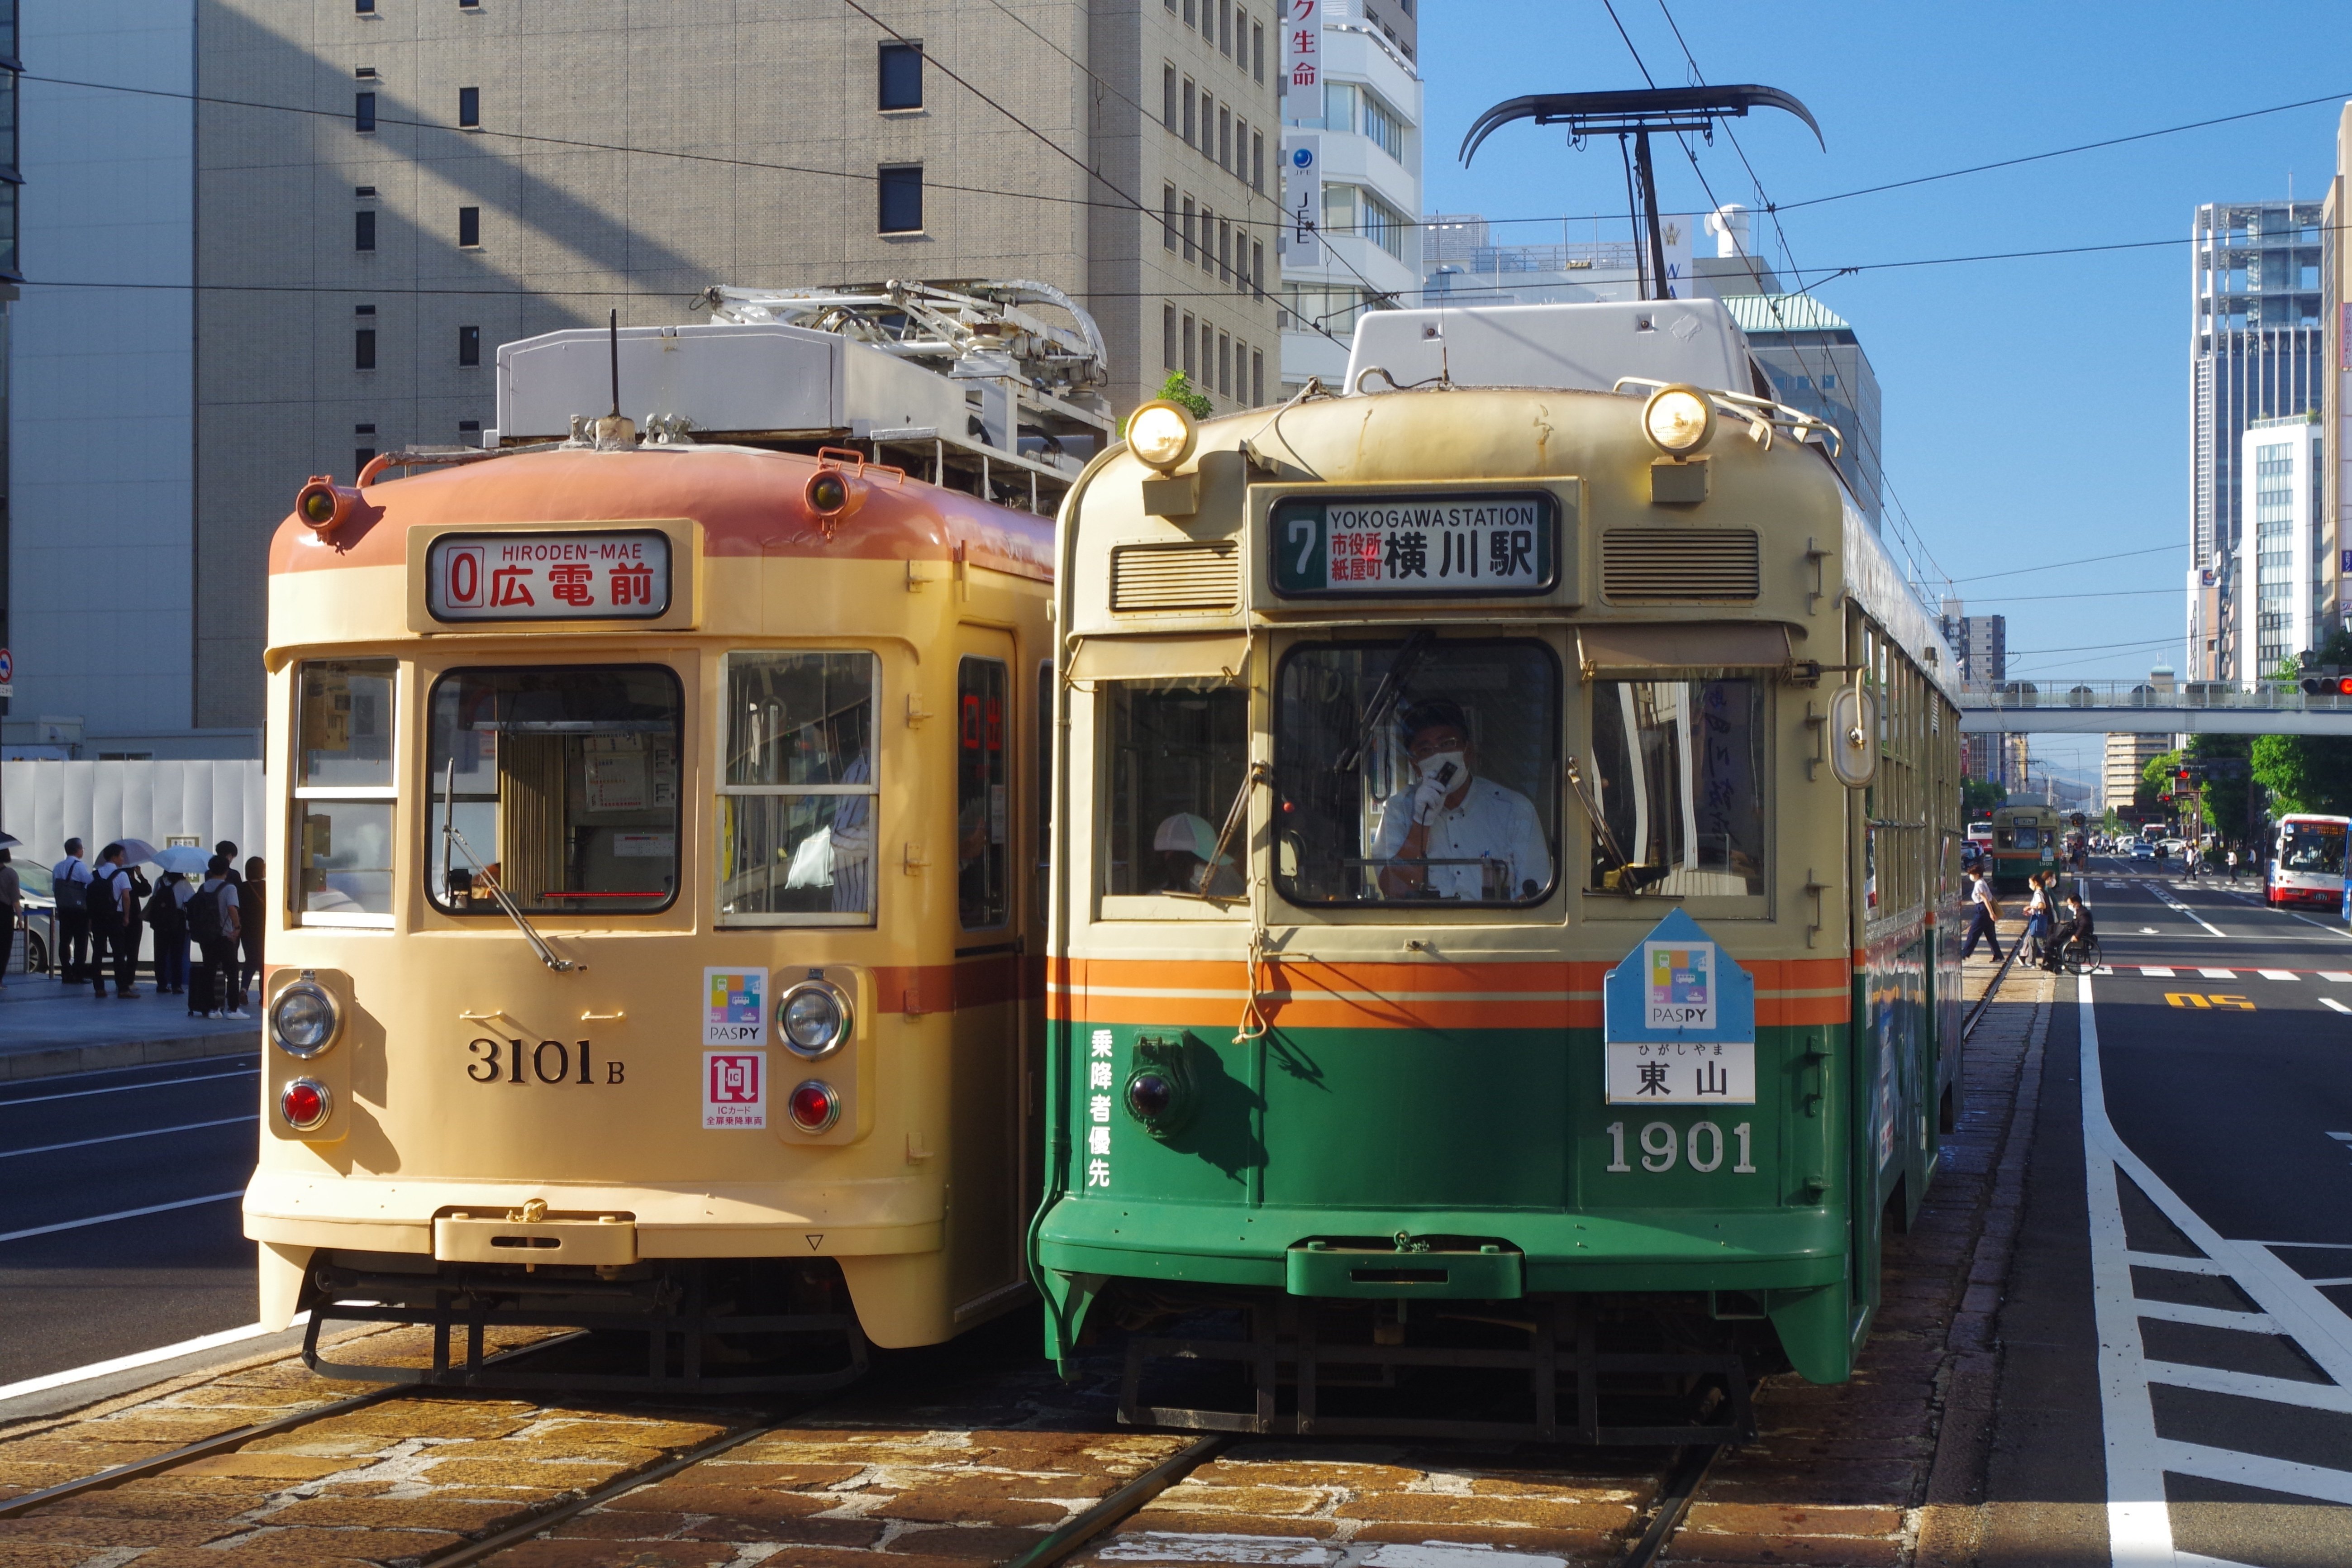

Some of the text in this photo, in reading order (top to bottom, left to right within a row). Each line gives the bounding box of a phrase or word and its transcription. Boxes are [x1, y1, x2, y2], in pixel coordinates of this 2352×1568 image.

[1297, 192, 1310, 244] JFE
[1331, 507, 1533, 529] YOKOGAWA STATION
[502, 543, 643, 561] HIRODEN-MAE
[1288, 520, 1316, 574] 7
[1332, 533, 1381, 557] 市役所
[1385, 530, 1532, 579] 横川駅
[452, 553, 478, 602] 0
[1332, 558, 1381, 581] 紙屋町
[490, 562, 653, 607] 広電前
[1653, 1008, 1707, 1022] PASPY
[710, 1027, 760, 1040] PASPY
[467, 1038, 625, 1084] 3101 B
[1638, 1044, 1723, 1056] ひがしやま
[730, 1073, 739, 1082] IC
[1636, 1061, 1726, 1096] 東山
[718, 1106, 751, 1115] ICカード
[1088, 1029, 1113, 1187] 乗降者優先
[706, 1116, 762, 1125] 全扉乗降車両
[1606, 1121, 1756, 1174] 1901
